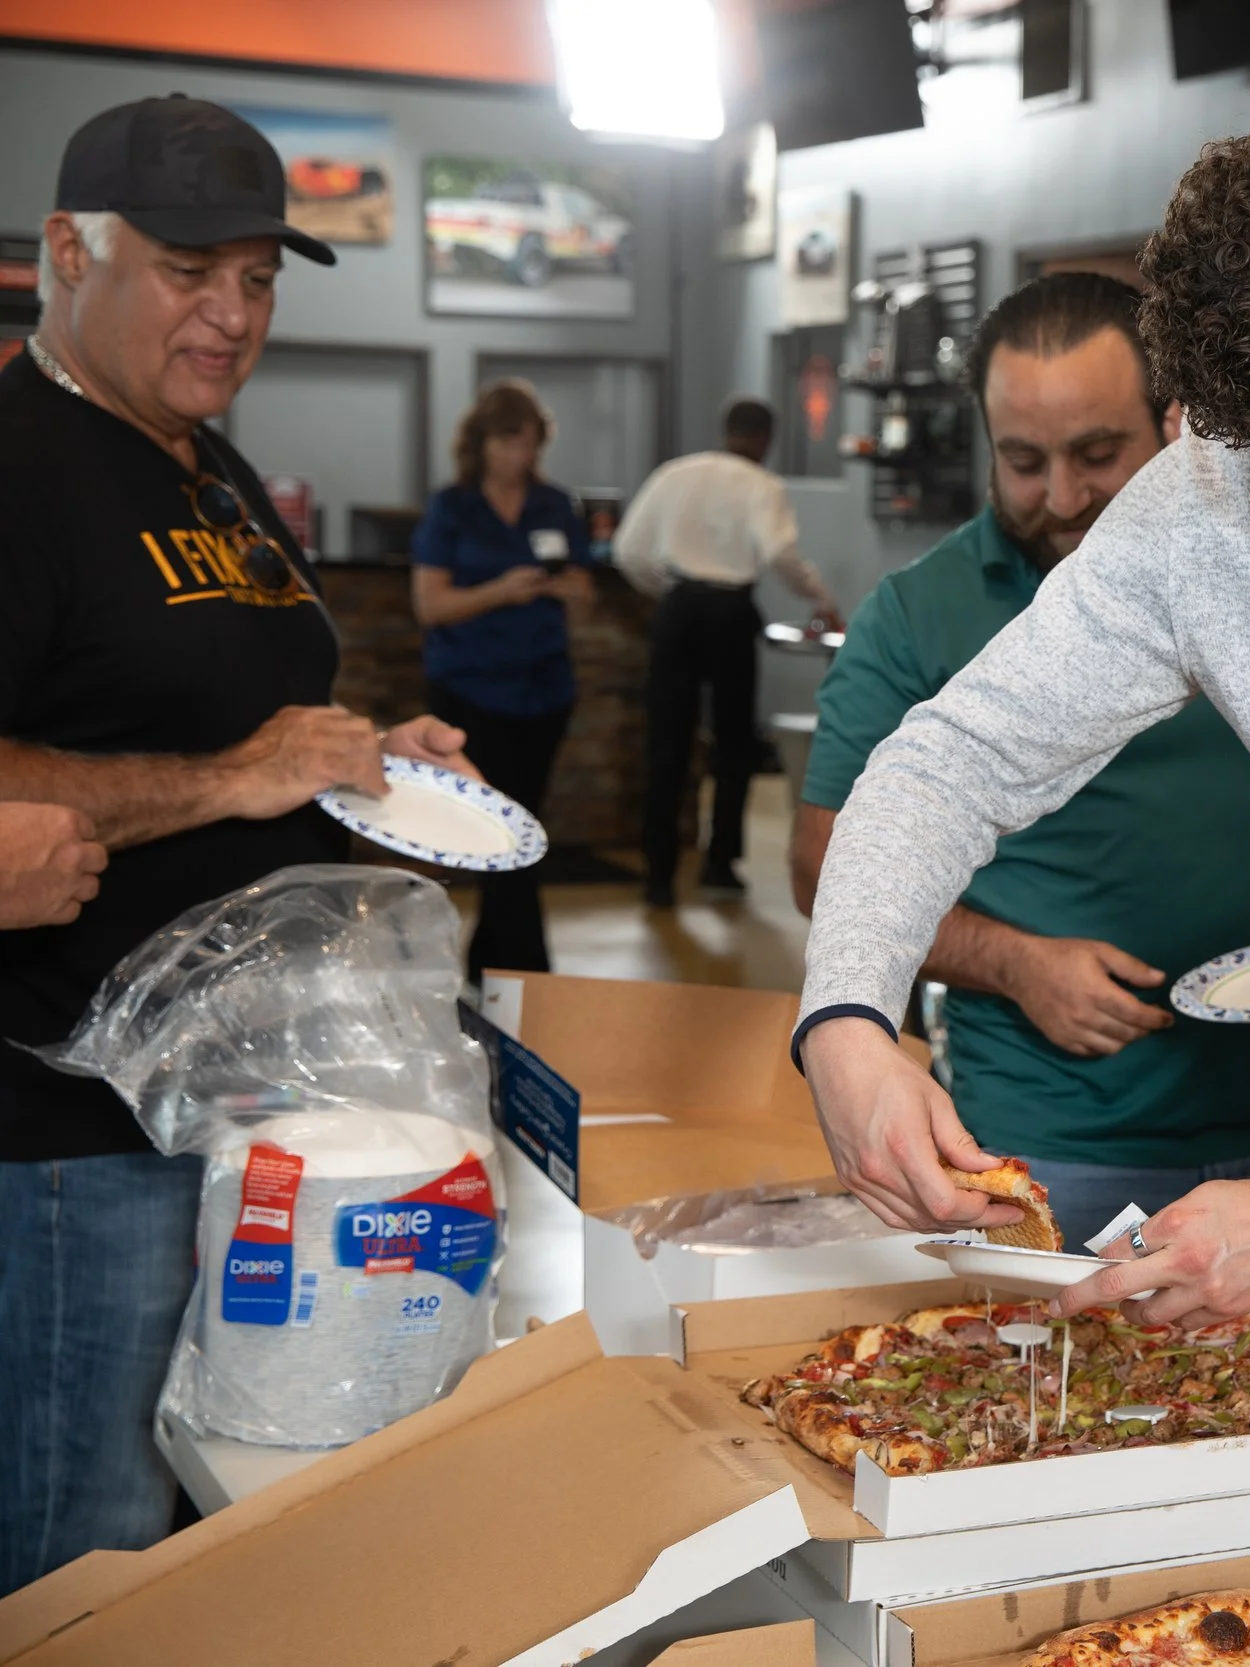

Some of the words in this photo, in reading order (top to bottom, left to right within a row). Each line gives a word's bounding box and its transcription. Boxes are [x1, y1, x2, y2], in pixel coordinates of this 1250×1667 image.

[139, 530, 183, 590] I
[362, 1236, 421, 1255] ULTRA
[402, 1295, 440, 1312] 240
